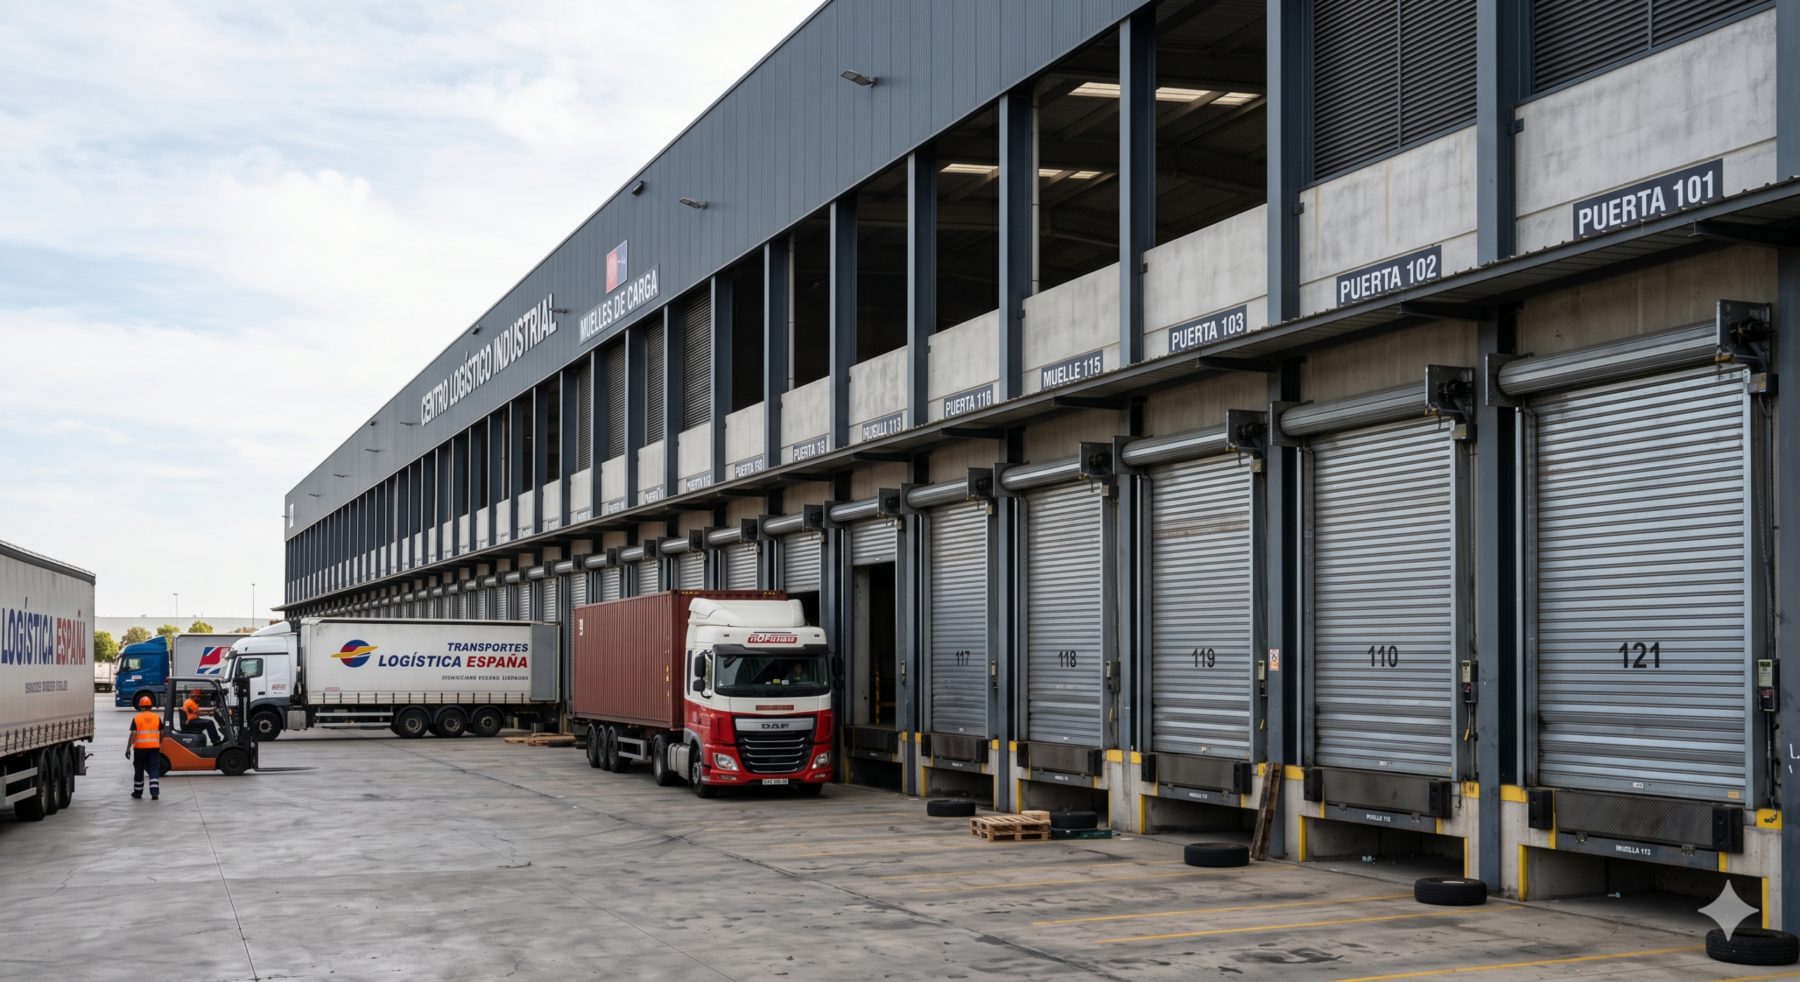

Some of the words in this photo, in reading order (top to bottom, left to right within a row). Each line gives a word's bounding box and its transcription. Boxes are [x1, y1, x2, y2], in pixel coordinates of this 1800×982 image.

[1578, 186, 1667, 235] PUERTA
[1672, 170, 1714, 207] 101
[1340, 265, 1402, 303] PUERTA
[1406, 254, 1437, 284] 102
[580, 300, 612, 342] MUELLES
[614, 290, 626, 320] DE
[627, 269, 658, 311] CARGA
[1171, 320, 1218, 351] PUERTA
[1221, 312, 1244, 336] 103
[421, 378, 449, 427] CENTRO
[450, 343, 492, 407] LOGÍSTICO
[493, 293, 558, 375] INDUSTRIAL
[1043, 361, 1081, 388] MUELLE
[1083, 356, 1101, 377] 115
[945, 394, 975, 418] PUERTA
[1, 596, 54, 666] LOGÍSTICA
[56, 608, 87, 666] ESPAÑA
[378, 652, 462, 668] LOGÍSTICA
[466, 653, 528, 668] ESPAÑA
[447, 642, 529, 653] TRANSPORTES
[955, 650, 970, 667] 117
[1058, 649, 1077, 668] 118
[1191, 647, 1215, 668] 119
[1367, 645, 1398, 668] 110
[1618, 641, 1660, 669] 121
